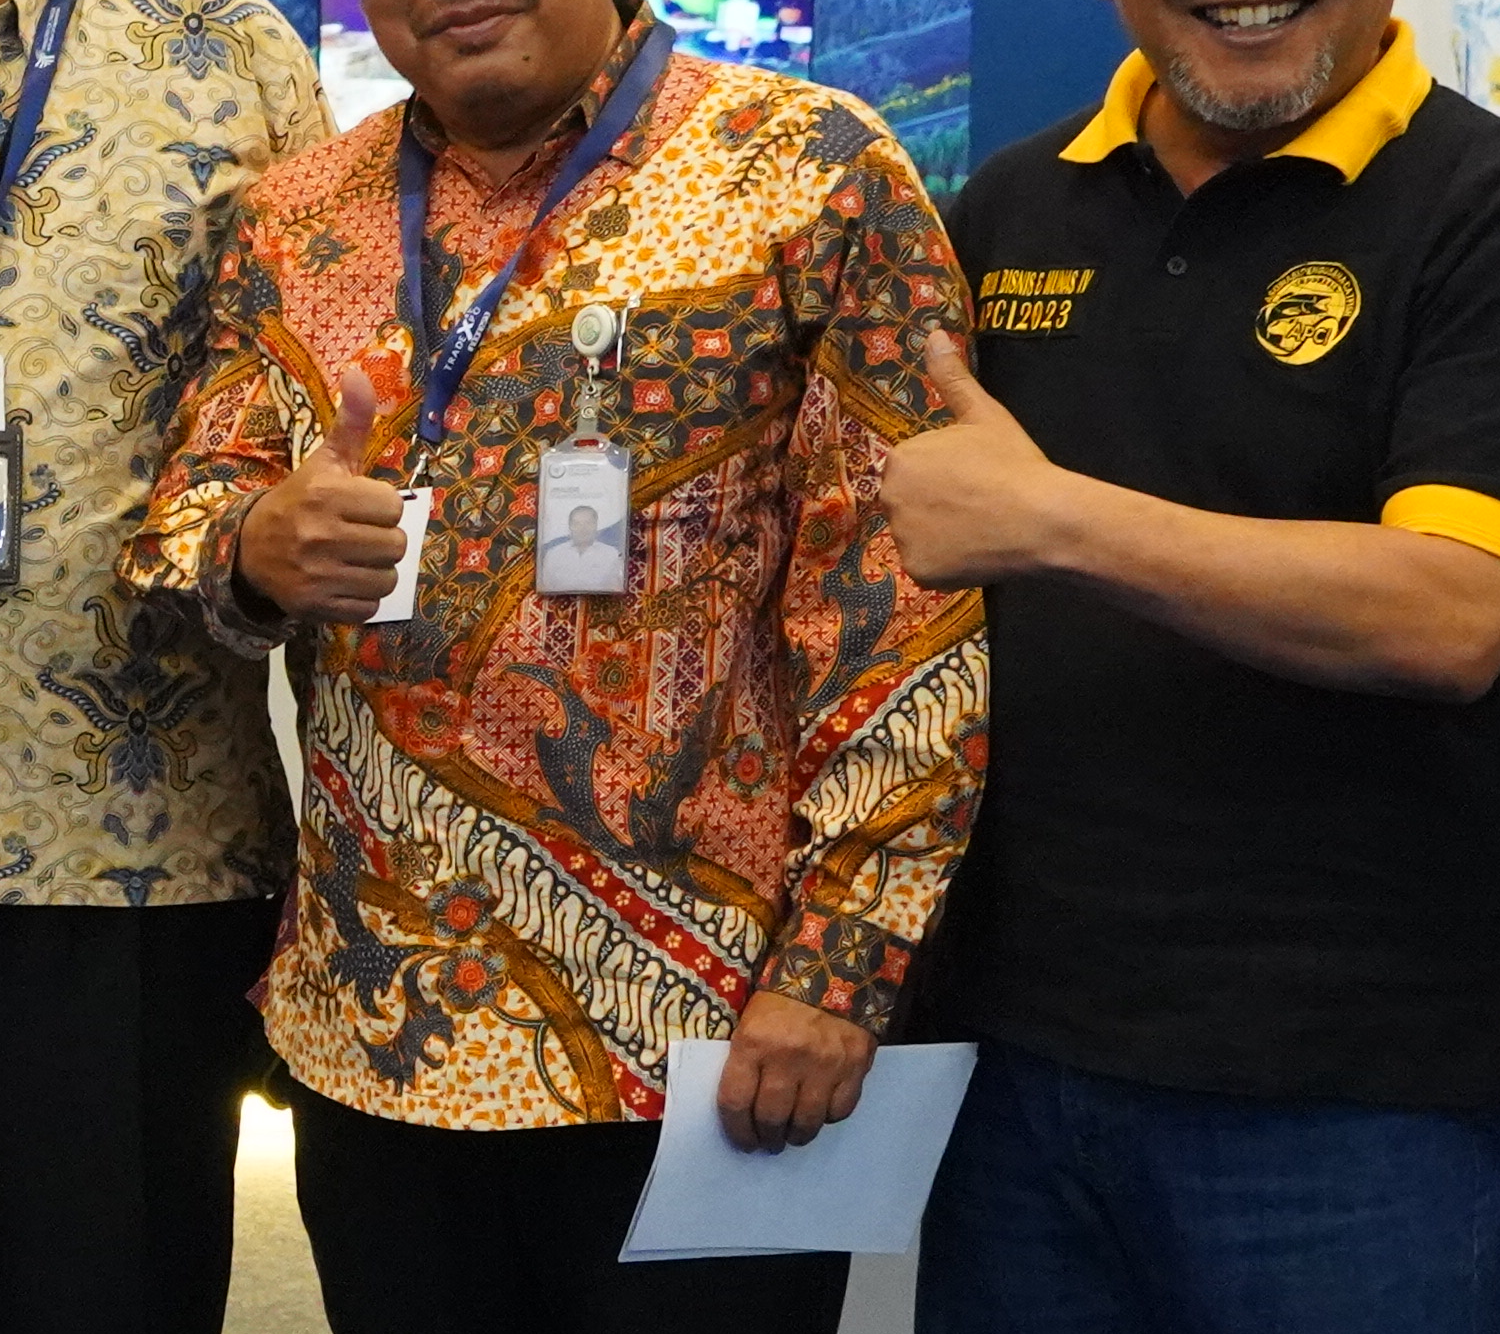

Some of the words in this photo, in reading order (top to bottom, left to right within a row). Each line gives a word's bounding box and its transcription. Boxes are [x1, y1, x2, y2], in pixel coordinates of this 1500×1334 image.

[998, 269, 1038, 296] BISNIS
[1014, 299, 1073, 331] 2023
[1286, 322, 1333, 346] APCI
